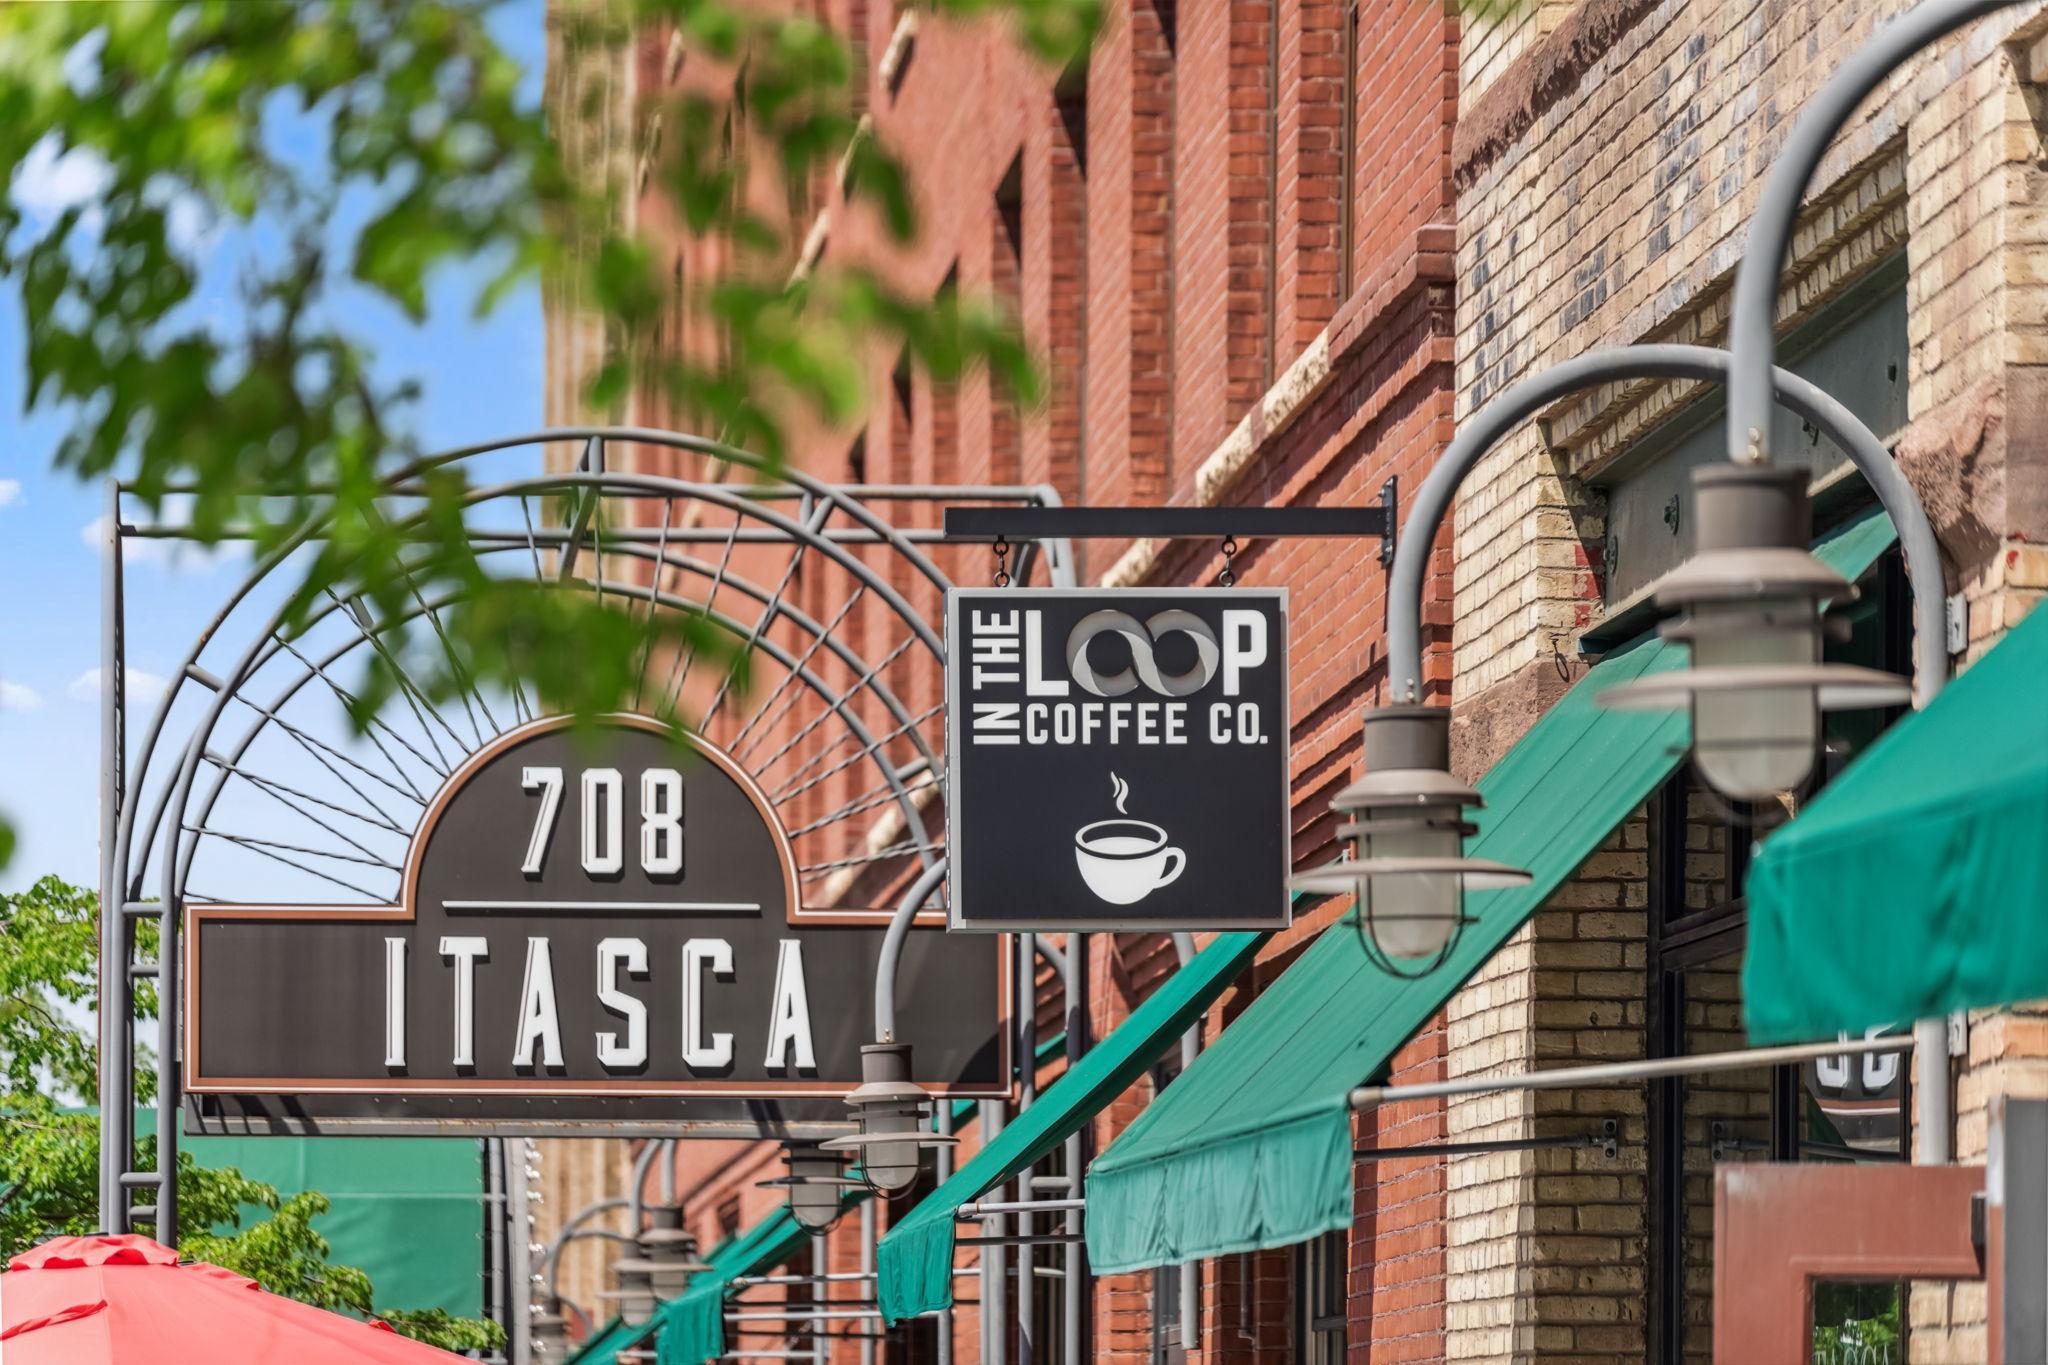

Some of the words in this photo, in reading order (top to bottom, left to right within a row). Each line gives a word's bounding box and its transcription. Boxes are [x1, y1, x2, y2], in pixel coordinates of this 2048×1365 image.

[971, 609, 1020, 691] THE
[1025, 608, 1268, 697] LOOP
[972, 702, 1021, 745] IN
[1025, 702, 1189, 745] COFFEE
[1208, 702, 1269, 745] CO.
[520, 766, 684, 876] 708
[383, 936, 817, 1069] ITASCA
